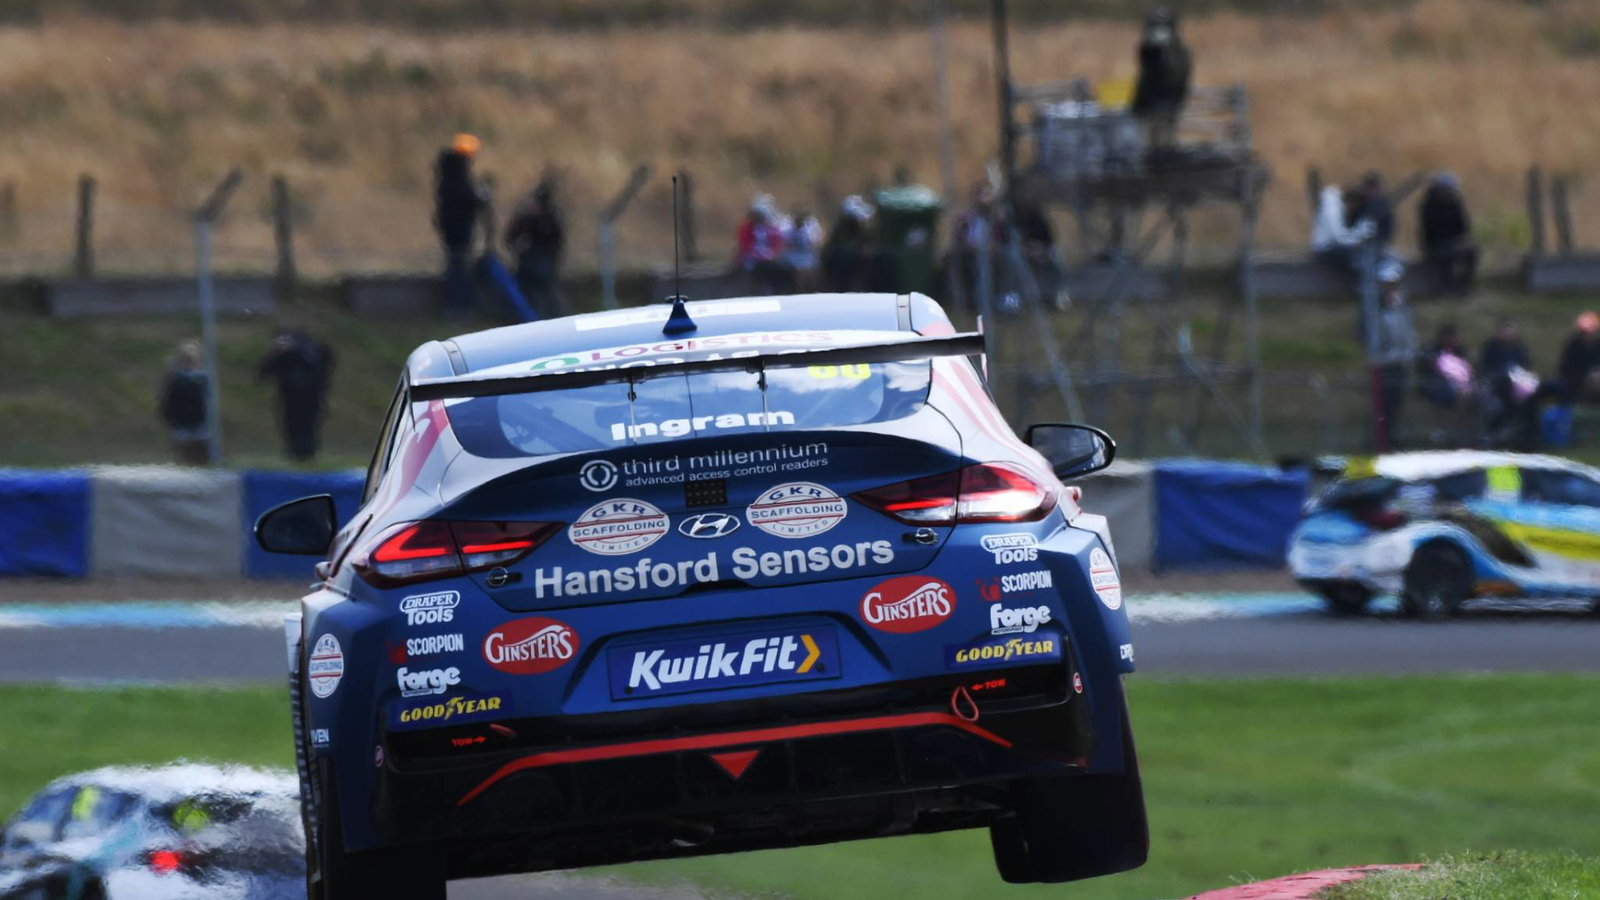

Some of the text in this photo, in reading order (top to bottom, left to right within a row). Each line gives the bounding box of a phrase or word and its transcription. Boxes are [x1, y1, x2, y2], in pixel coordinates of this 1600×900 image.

[592, 332, 833, 361] LOGISTICS
[611, 408, 795, 441] Ingram
[622, 442, 829, 476] third millennium
[625, 457, 829, 487] advanced access control readers
[768, 486, 823, 501] GKR
[591, 503, 646, 518] GKR
[751, 504, 844, 519] SCAFFOLDING
[573, 520, 666, 538] SCAFFOLDING
[992, 546, 1039, 565] Tools
[534, 539, 895, 599] Hansford Sensors
[1001, 570, 1052, 593] SCORPION
[404, 593, 454, 609] DRAPER
[404, 606, 454, 626] Tools
[406, 633, 464, 657] SCORPION
[955, 638, 1054, 663] GOODYEAR
[985, 679, 1007, 689] TOW
[400, 696, 502, 722] GOODYEAR
